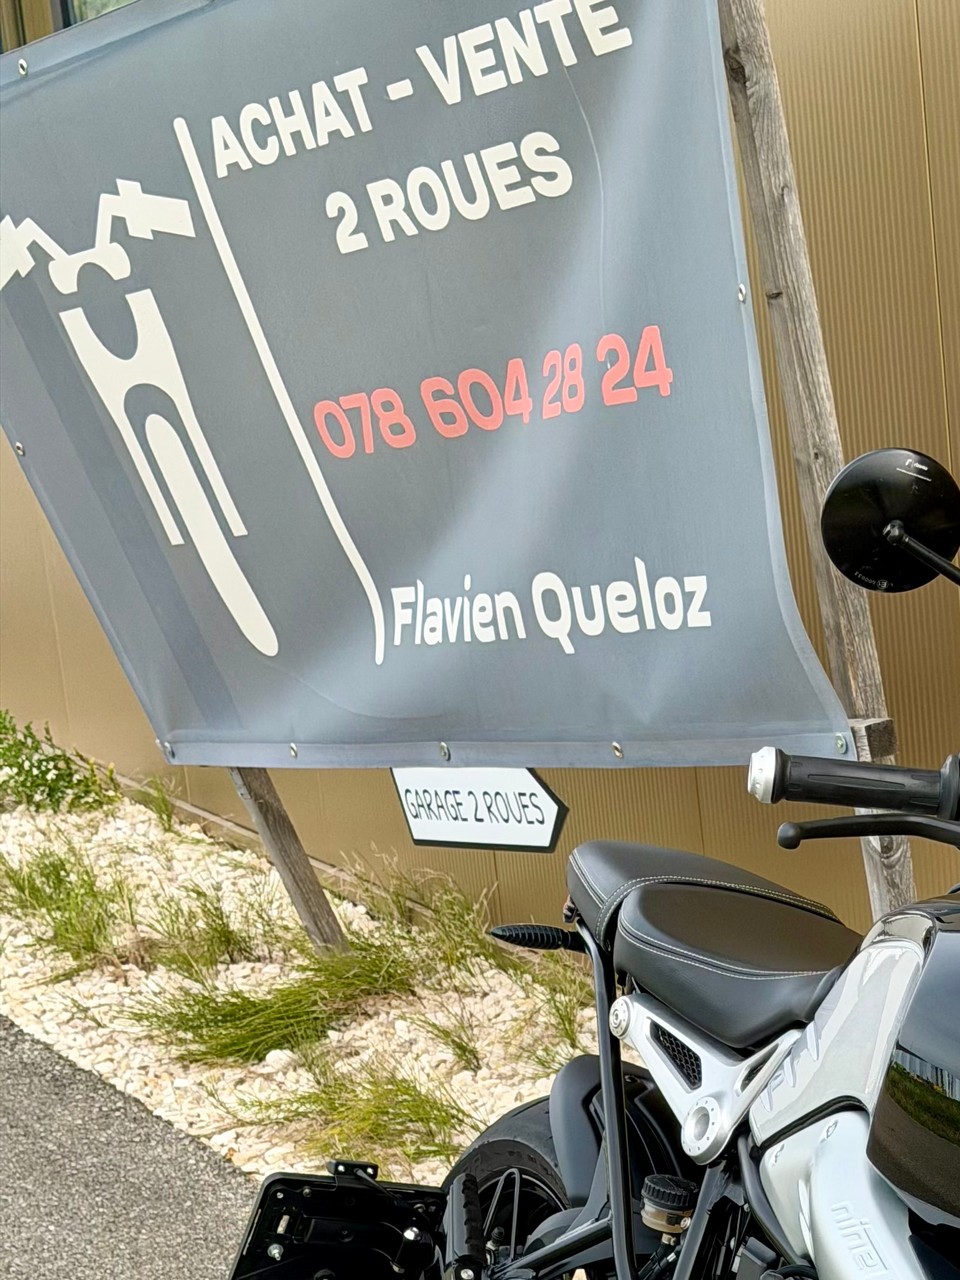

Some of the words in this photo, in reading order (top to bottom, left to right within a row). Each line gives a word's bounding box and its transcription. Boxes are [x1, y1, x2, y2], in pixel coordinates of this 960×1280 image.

[211, 67, 373, 179] ACHAT
[415, 0, 633, 106] VENTE
[325, 191, 369, 254] 2
[366, 131, 573, 243] ROUES
[314, 387, 417, 459] 078
[420, 358, 533, 438] 604
[542, 343, 585, 420] 28
[596, 325, 673, 406] 24
[391, 574, 527, 646] Flavien
[531, 556, 712, 654] Queloz
[404, 788, 468, 822] GARAGE
[467, 790, 484, 823] 2
[482, 791, 545, 825] ROUES
